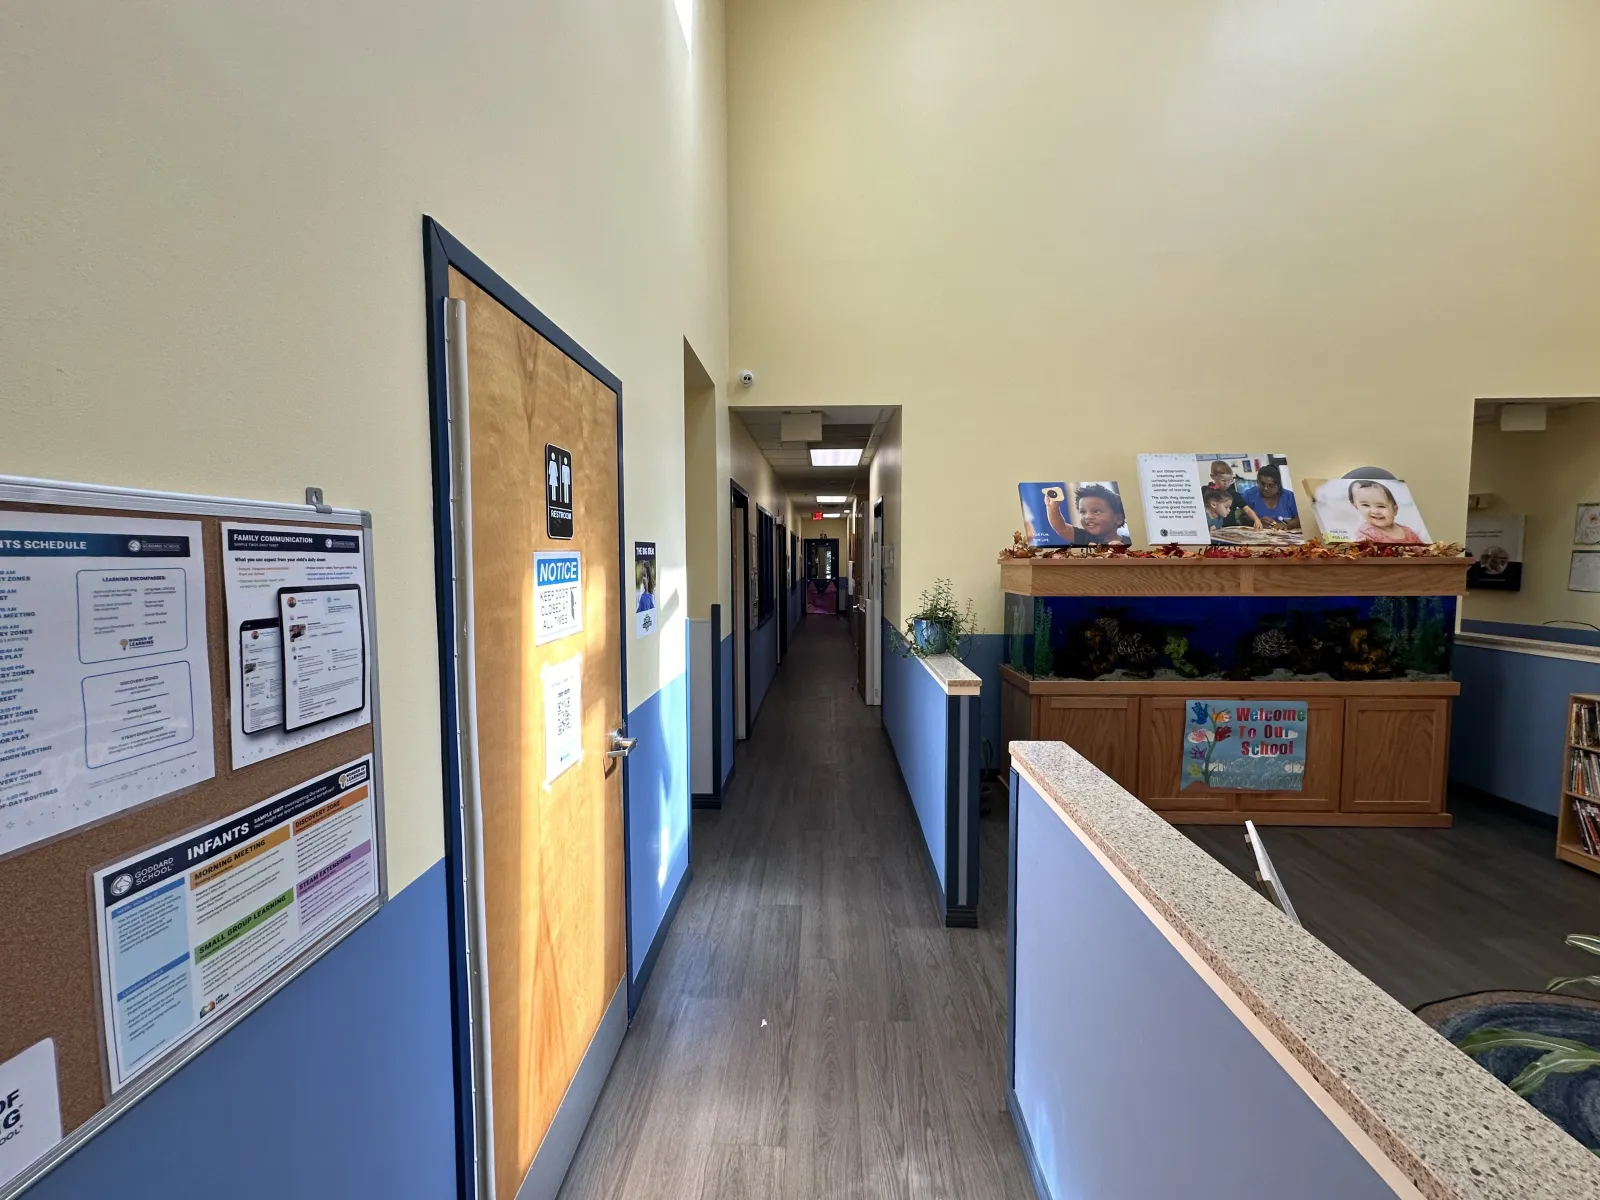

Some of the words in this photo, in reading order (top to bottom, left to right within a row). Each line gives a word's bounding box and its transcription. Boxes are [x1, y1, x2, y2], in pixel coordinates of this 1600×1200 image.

[550, 510, 572, 520] RESTROOM
[24, 540, 86, 550] SCHEDULE
[540, 561, 577, 582] NOTICE
[540, 590, 554, 602] KEEP
[543, 620, 553, 630] ALL
[15, 709, 39, 717] ZONES
[1236, 708, 1306, 722] Welcome
[12, 733, 30, 742] PLAY
[1238, 725, 1256, 739] To
[1264, 725, 1290, 739] Our
[21, 745, 52, 757] MEETING
[1242, 741, 1294, 755] School
[20, 770, 42, 780] ZONES
[347, 772, 365, 782] LEARNING
[24, 788, 58, 802] ROUTINES
[254, 810, 272, 824] SAMPLE
[273, 805, 284, 814] UNIT
[295, 808, 326, 827] DISCOVERY
[327, 801, 340, 811] ZONE
[188, 823, 249, 860] INFANTS
[195, 856, 232, 880] MORNING
[234, 840, 266, 860] MEETING
[134, 857, 174, 879] GODDARD
[299, 874, 318, 890] STEAM
[320, 853, 351, 877] EXTENSIONS
[136, 865, 172, 886] SCHOOL
[200, 935, 226, 953] SMALL
[228, 917, 252, 936] GROUP
[253, 895, 286, 919] LEARNING
